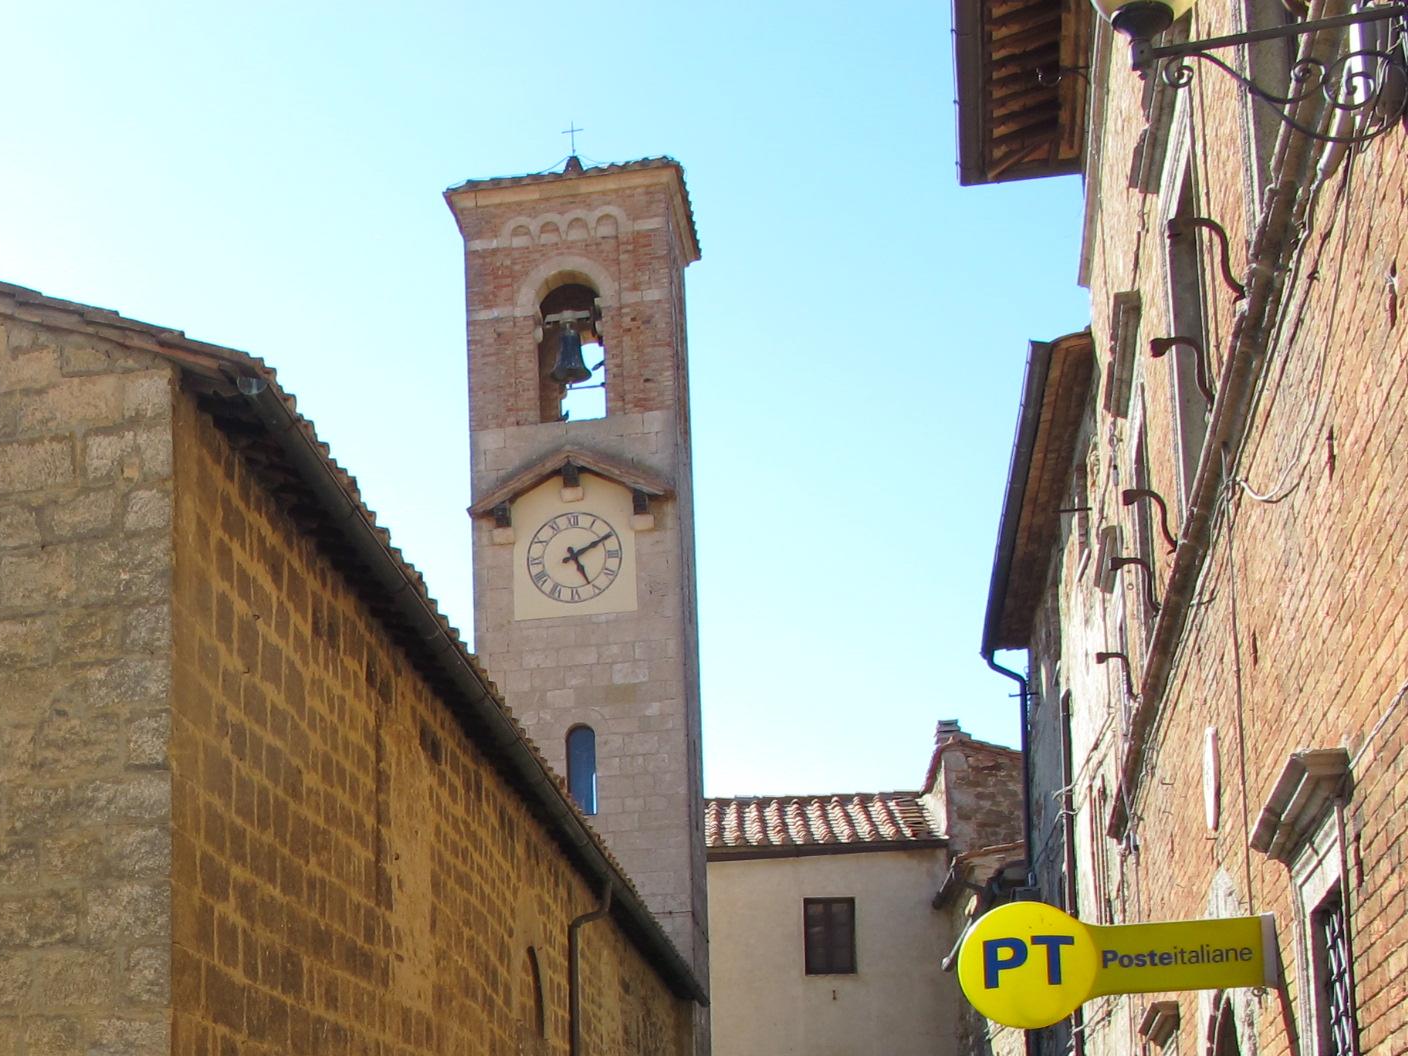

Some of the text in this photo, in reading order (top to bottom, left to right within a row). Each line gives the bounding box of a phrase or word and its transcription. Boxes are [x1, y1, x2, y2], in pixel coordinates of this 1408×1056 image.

[567, 515, 578, 526] XII
[590, 519, 596, 529] I
[535, 537, 548, 546] X
[607, 549, 619, 558] III
[591, 584, 601, 594] V
[982, 935, 1075, 989] PT
